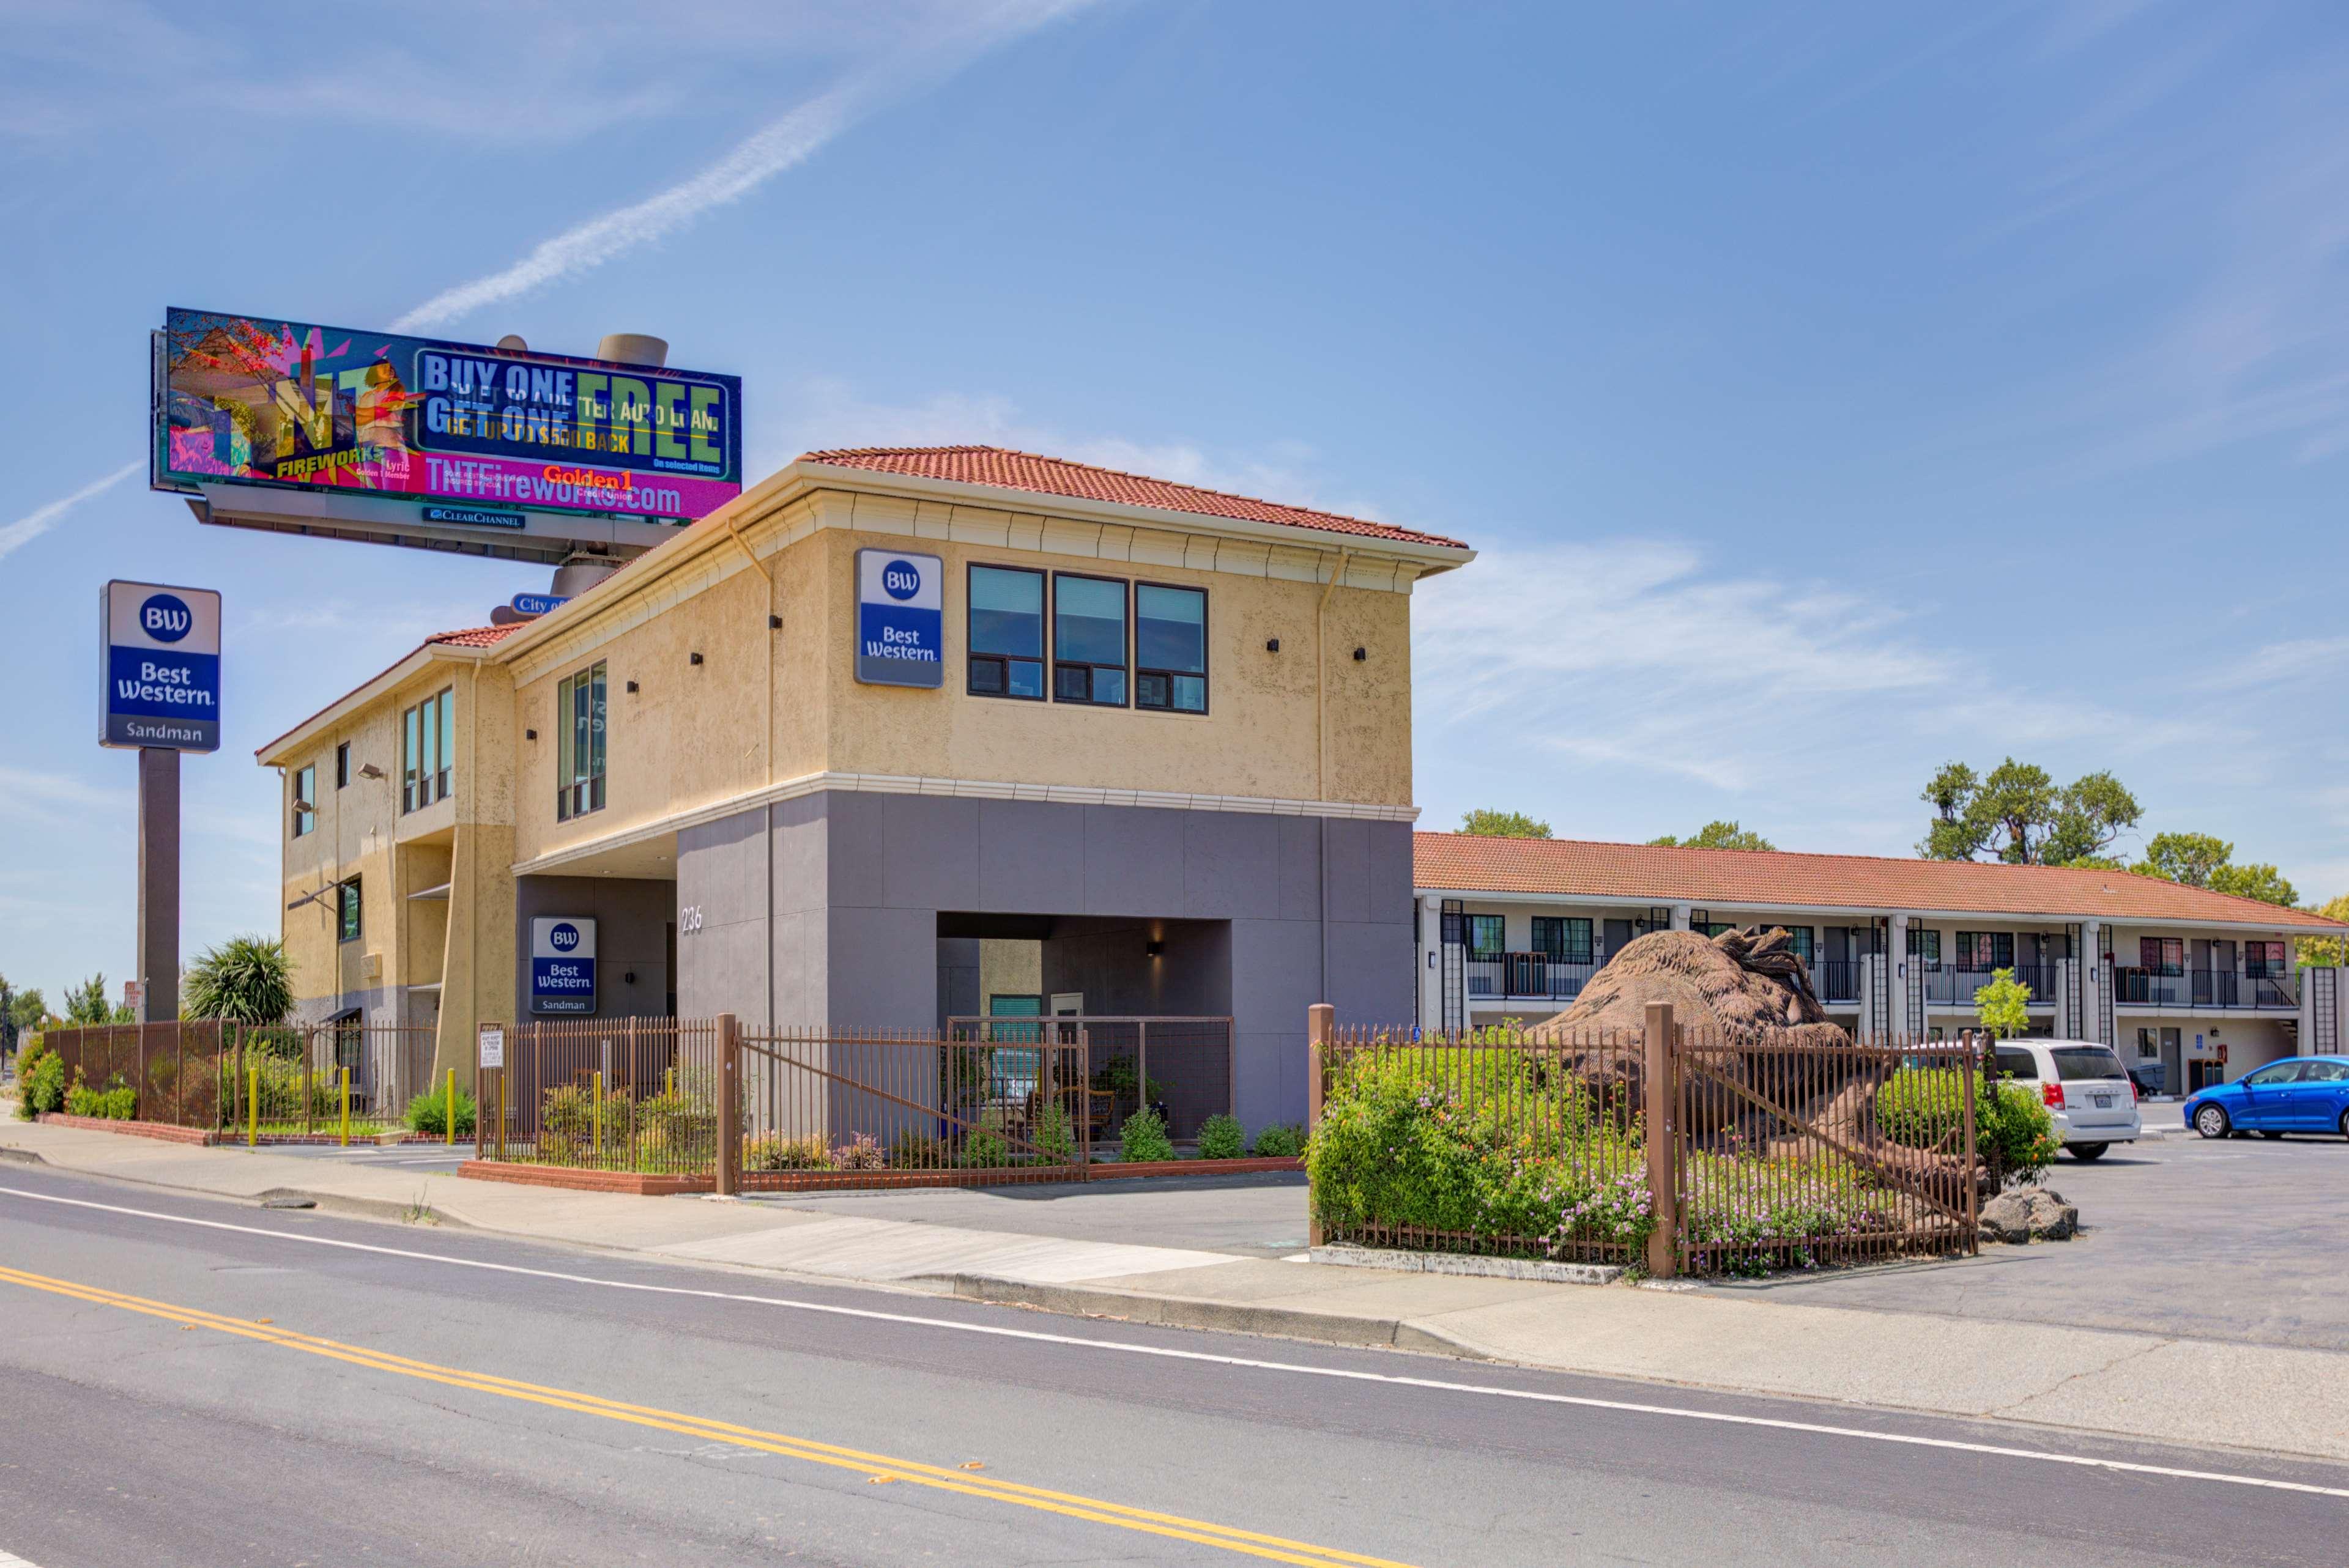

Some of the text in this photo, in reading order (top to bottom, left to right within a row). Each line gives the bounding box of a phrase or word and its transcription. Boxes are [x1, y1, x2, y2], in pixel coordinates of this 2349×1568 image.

[425, 355, 573, 407] BUY ONE
[427, 397, 569, 445] GET ONE
[577, 372, 721, 464] FREE
[620, 401, 665, 425] AUTO
[670, 407, 719, 432] LOAN.
[447, 416, 629, 454] GET UP TO $500 BACK
[278, 445, 384, 478] FIREWORKS
[386, 460, 410, 473] Lyric
[653, 459, 720, 474] On selected items
[356, 468, 378, 477] Golden
[385, 471, 410, 480] Member
[577, 487, 633, 501] Credit Union
[887, 571, 917, 592] BW
[519, 597, 547, 614] City
[146, 607, 187, 632] BW
[883, 626, 919, 645] Best
[141, 662, 191, 686] Best
[127, 722, 202, 742] Sandman
[681, 905, 702, 932] 236
[553, 931, 577, 946] BW
[551, 964, 579, 977] Best
[542, 1000, 585, 1010] Sandman
